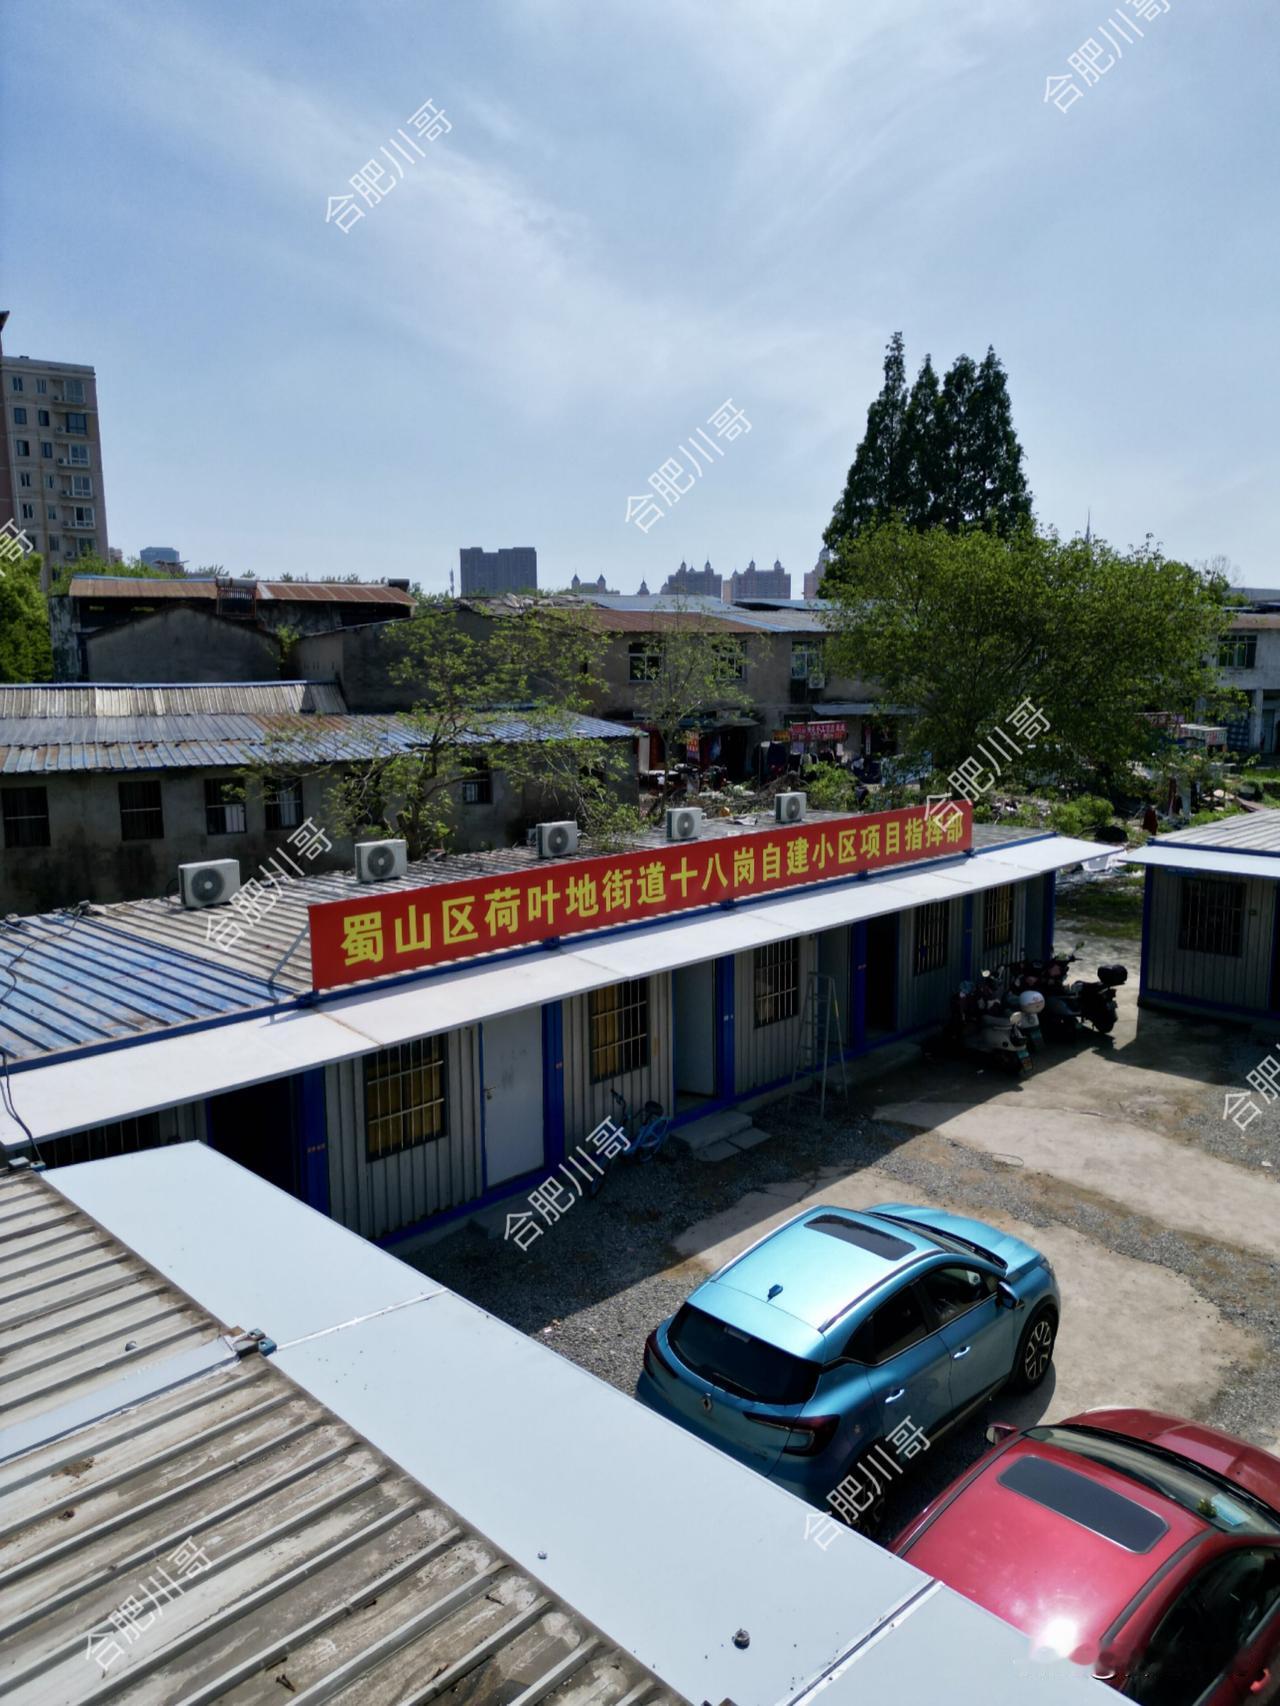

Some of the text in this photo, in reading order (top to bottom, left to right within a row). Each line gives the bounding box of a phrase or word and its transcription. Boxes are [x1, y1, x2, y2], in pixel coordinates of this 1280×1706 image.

[340, 811, 963, 967] 蜀山区荷叶地街道十八岗自建小区项目指挥部
